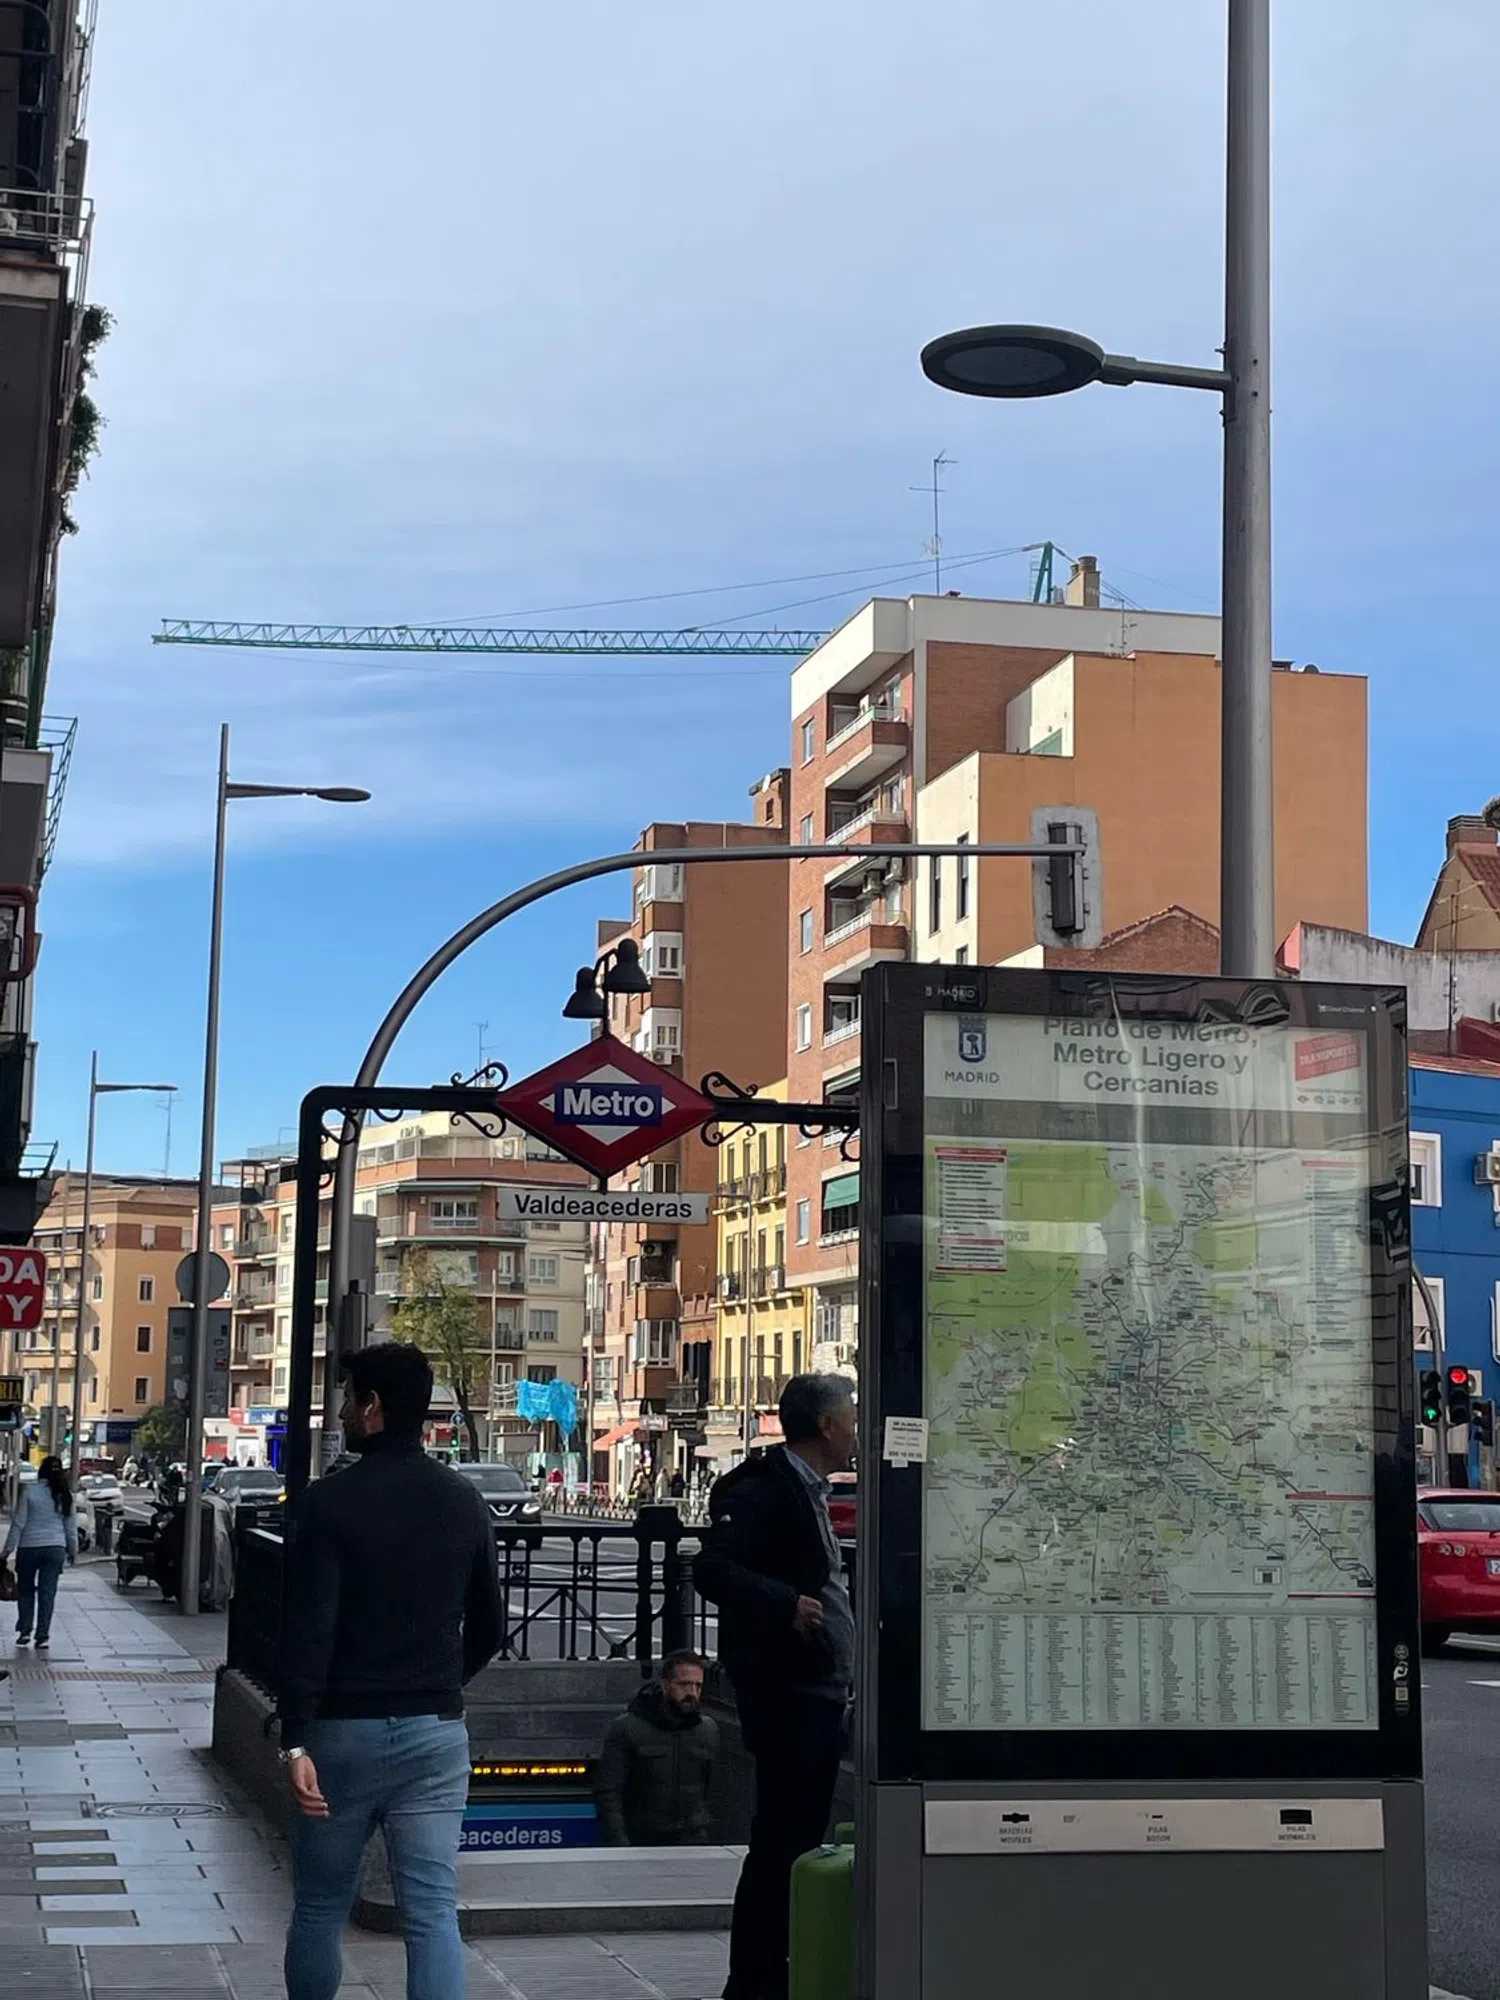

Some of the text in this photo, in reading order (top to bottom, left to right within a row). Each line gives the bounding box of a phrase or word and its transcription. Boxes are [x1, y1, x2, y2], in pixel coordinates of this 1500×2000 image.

[1044, 1017, 1119, 1039] Plano
[1130, 1021, 1162, 1040] de
[1053, 1043, 1249, 1075] Metro Ligero y
[945, 1070, 1000, 1084] MADRID
[1083, 1071, 1219, 1096] Cercanías
[563, 1088, 656, 1118] Metro
[514, 1194, 693, 1219] Valdeacederas
[0, 1295, 34, 1322] Y
